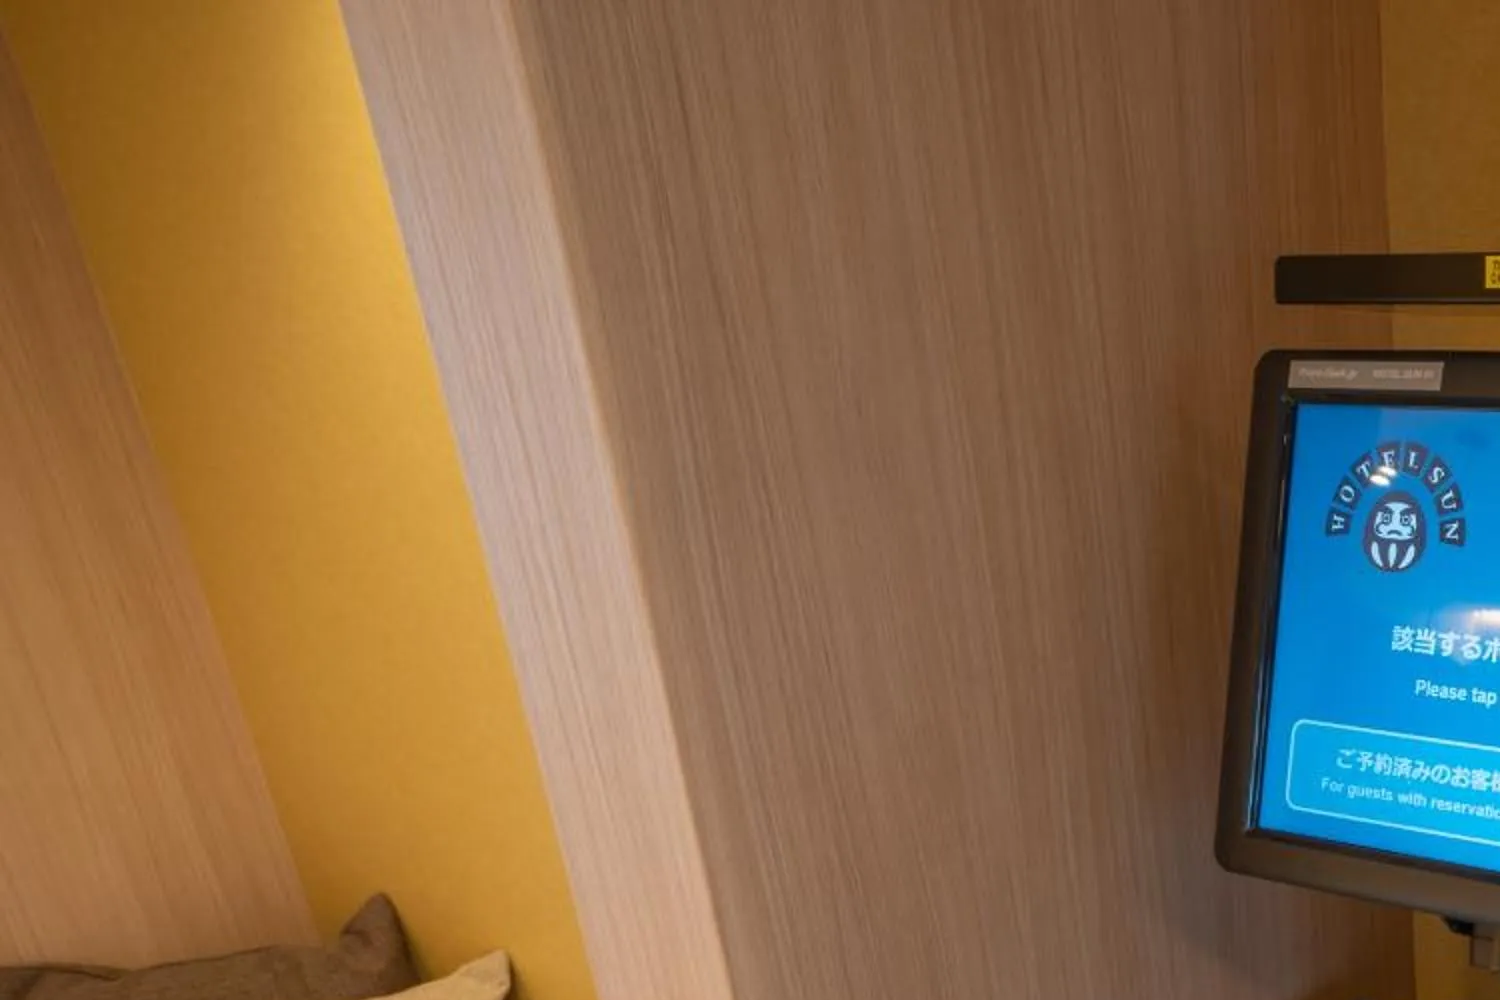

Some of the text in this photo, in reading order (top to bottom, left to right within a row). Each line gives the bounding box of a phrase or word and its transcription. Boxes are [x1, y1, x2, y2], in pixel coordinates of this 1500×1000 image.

[1331, 450, 1460, 541] HOTEL SUN
[1415, 679, 1467, 702] Please
[1471, 687, 1497, 707] tap
[1320, 776, 1345, 793] For
[1347, 783, 1394, 803] guests
[1397, 791, 1428, 808] with
